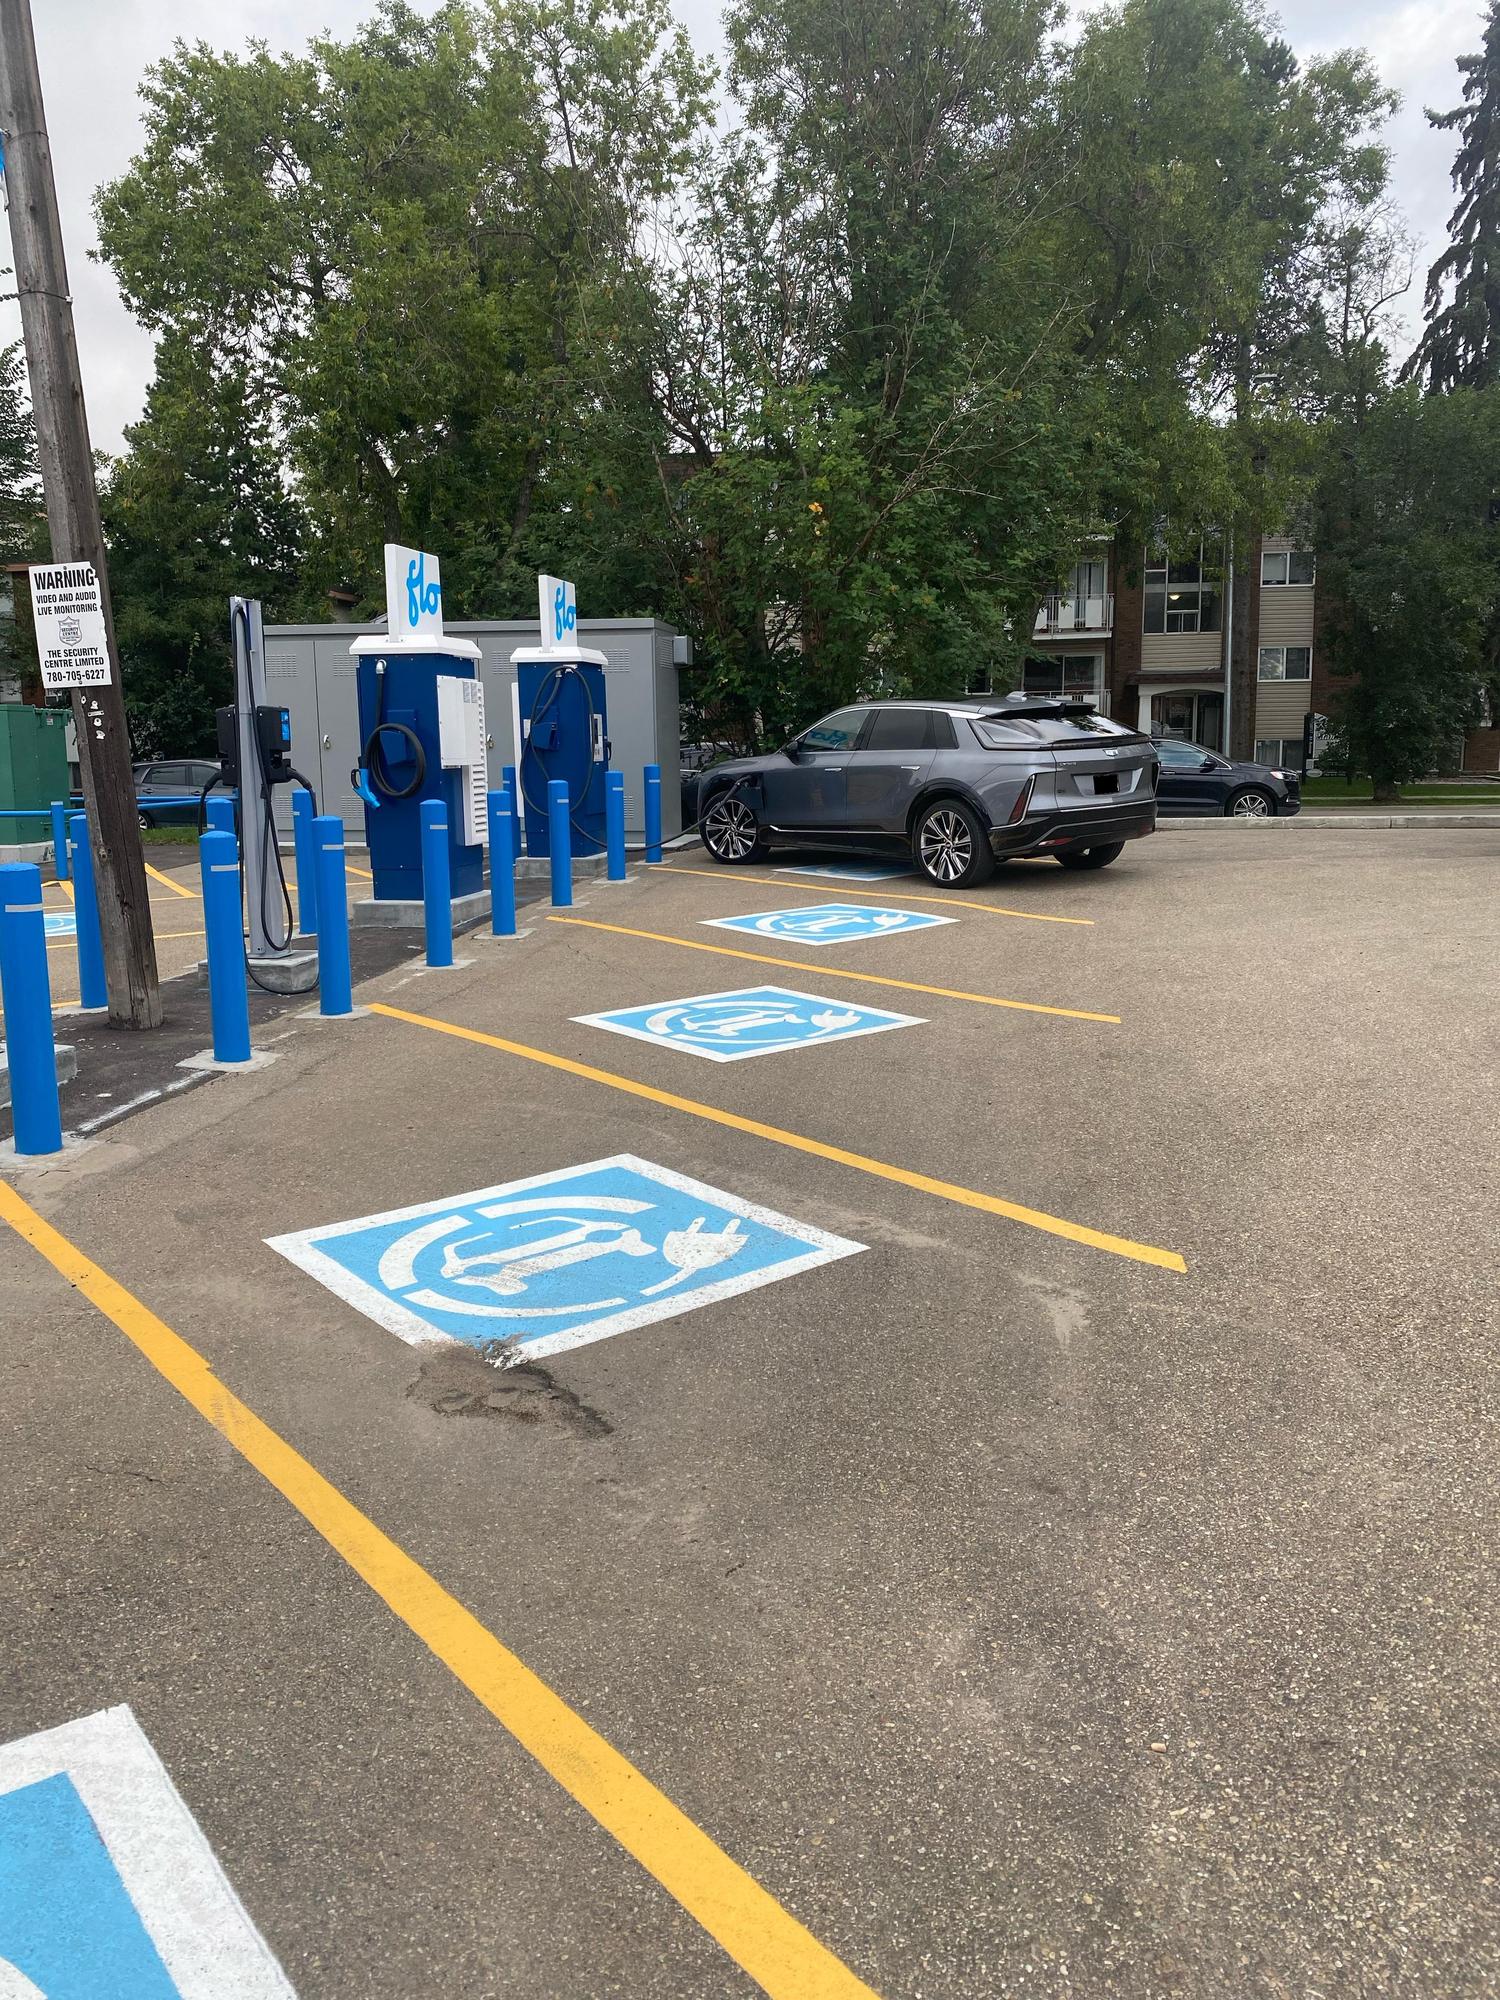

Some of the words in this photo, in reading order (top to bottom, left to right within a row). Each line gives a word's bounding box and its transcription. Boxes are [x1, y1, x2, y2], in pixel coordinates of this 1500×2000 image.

[34, 568, 94, 590] WARNING
[406, 552, 441, 627] flo
[36, 594, 57, 604] VIDEO
[58, 593, 74, 603] AND
[75, 591, 96, 601] AUDIO
[37, 607, 53, 616] LIVE
[54, 603, 97, 614] MONITORING
[554, 581, 577, 641] flo
[47, 649, 62, 658] THE
[63, 647, 98, 658] SECURITY
[44, 658, 73, 668] CENTRE
[75, 657, 105, 667] LIMITED
[47, 669, 105, 682] 780-705-6227
